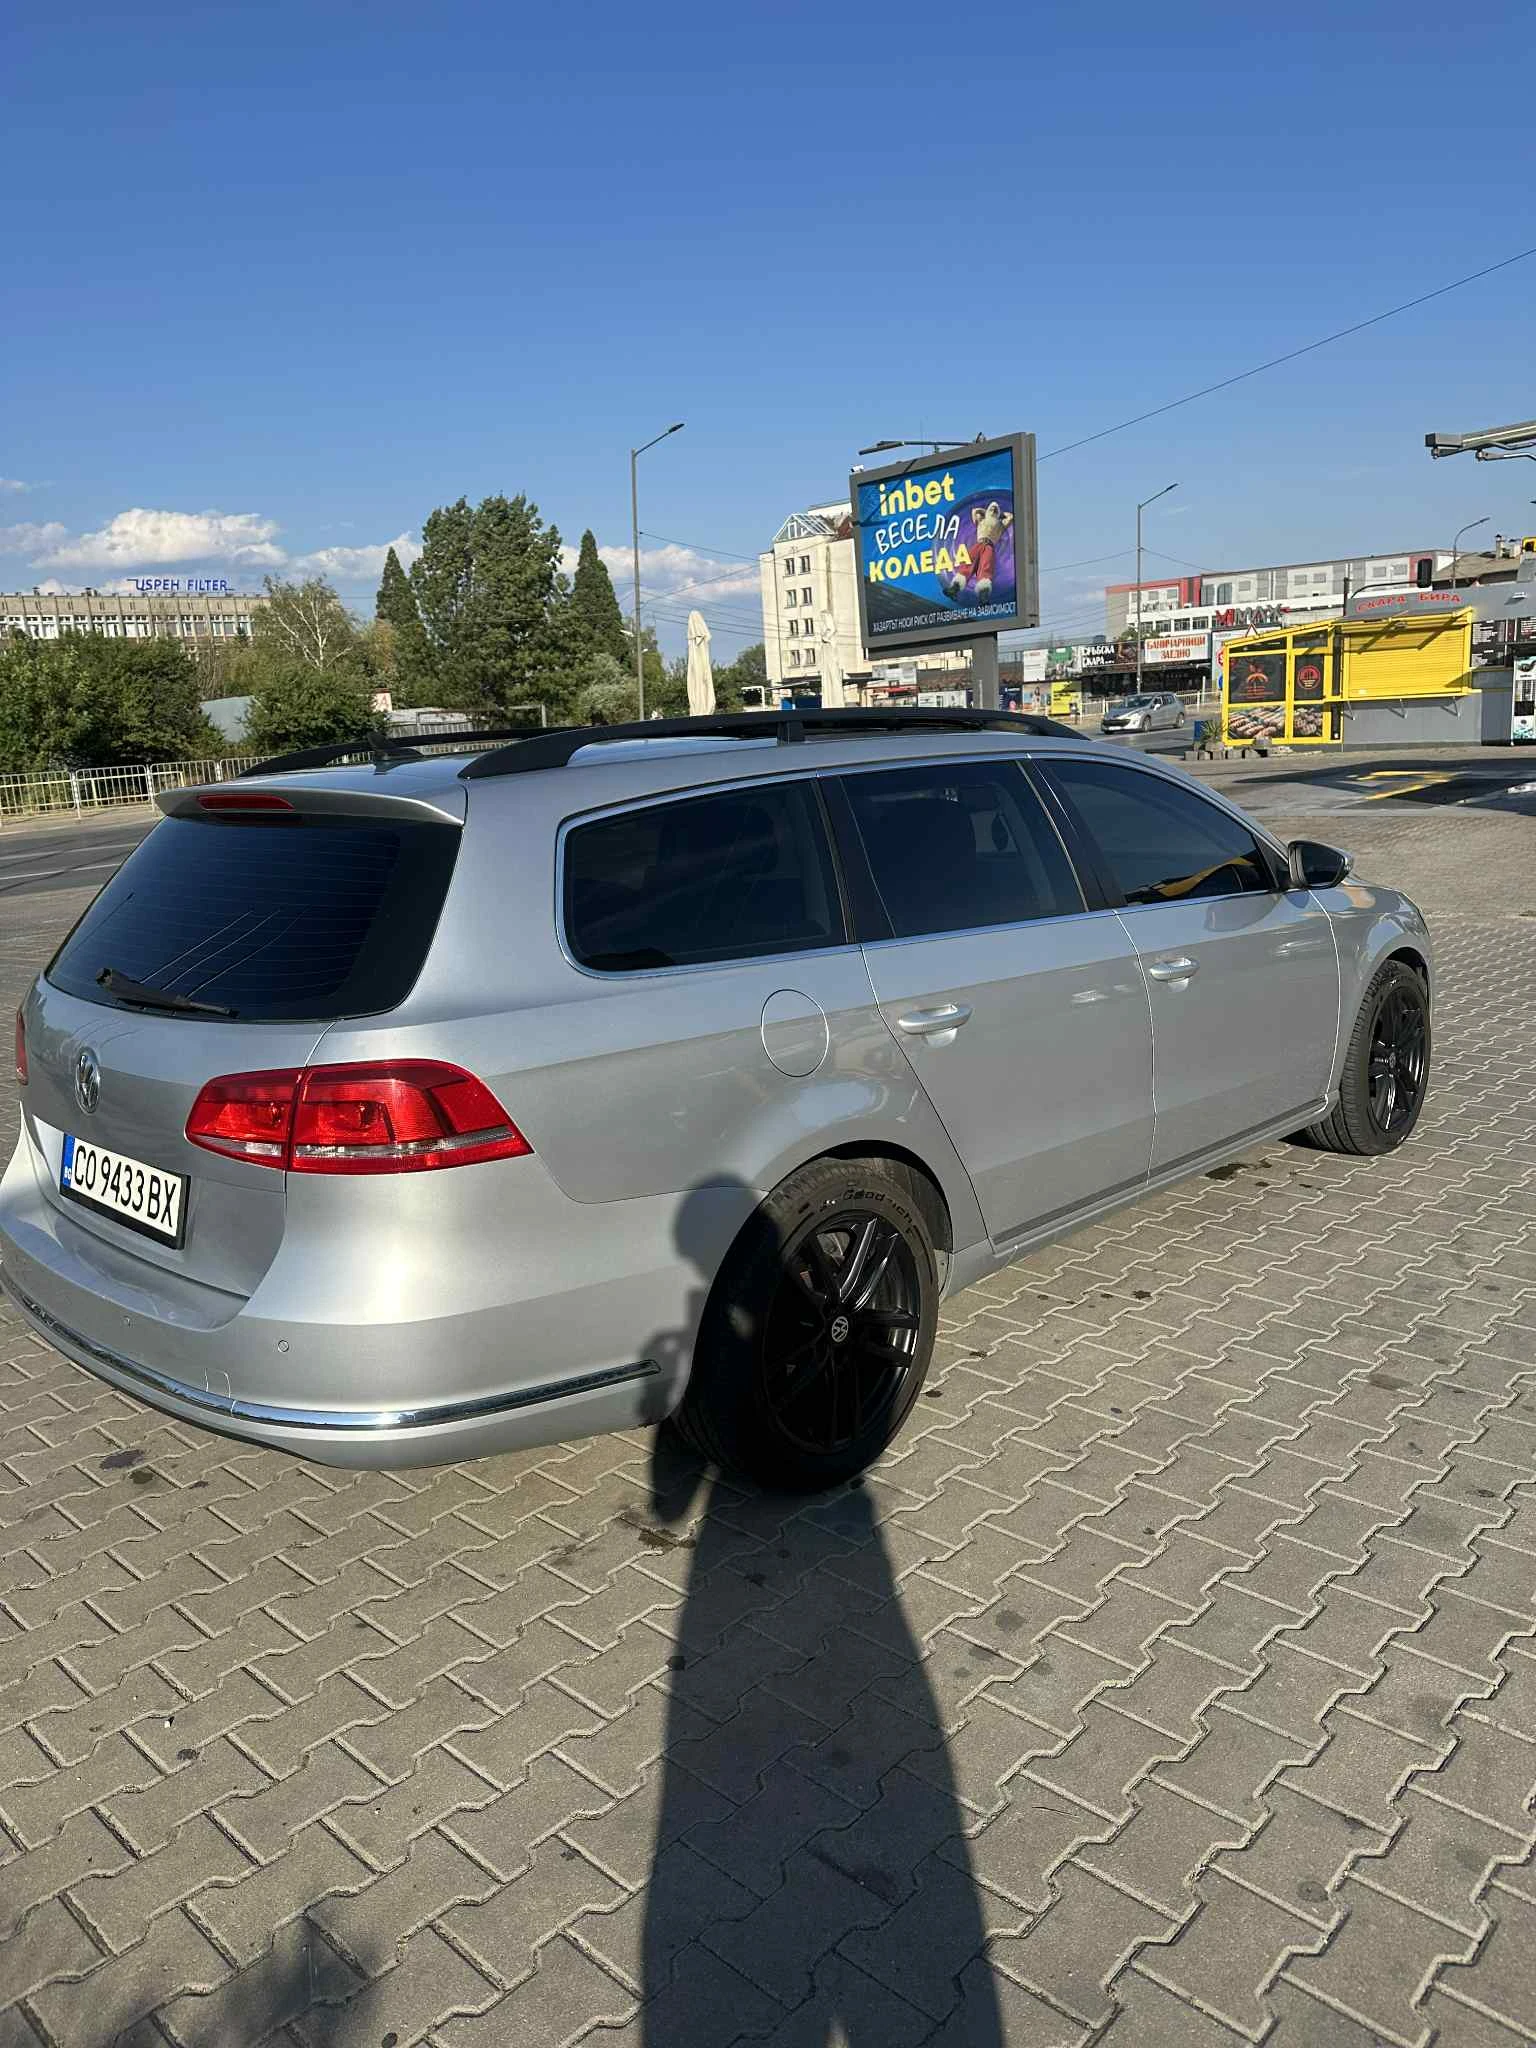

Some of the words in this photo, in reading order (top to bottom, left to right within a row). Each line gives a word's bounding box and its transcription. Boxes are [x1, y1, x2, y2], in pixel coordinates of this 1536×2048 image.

[879, 472, 955, 516] inbet
[875, 514, 960, 555] ВЕСЕЛА
[869, 544, 972, 583] КОЛЕДА
[129, 578, 180, 591] USPEH
[187, 579, 229, 591] FILTER
[1419, 592, 1461, 603] БИРА
[74, 1145, 97, 1190] CO
[101, 1156, 145, 1212] 9433
[147, 1175, 177, 1228] BX
